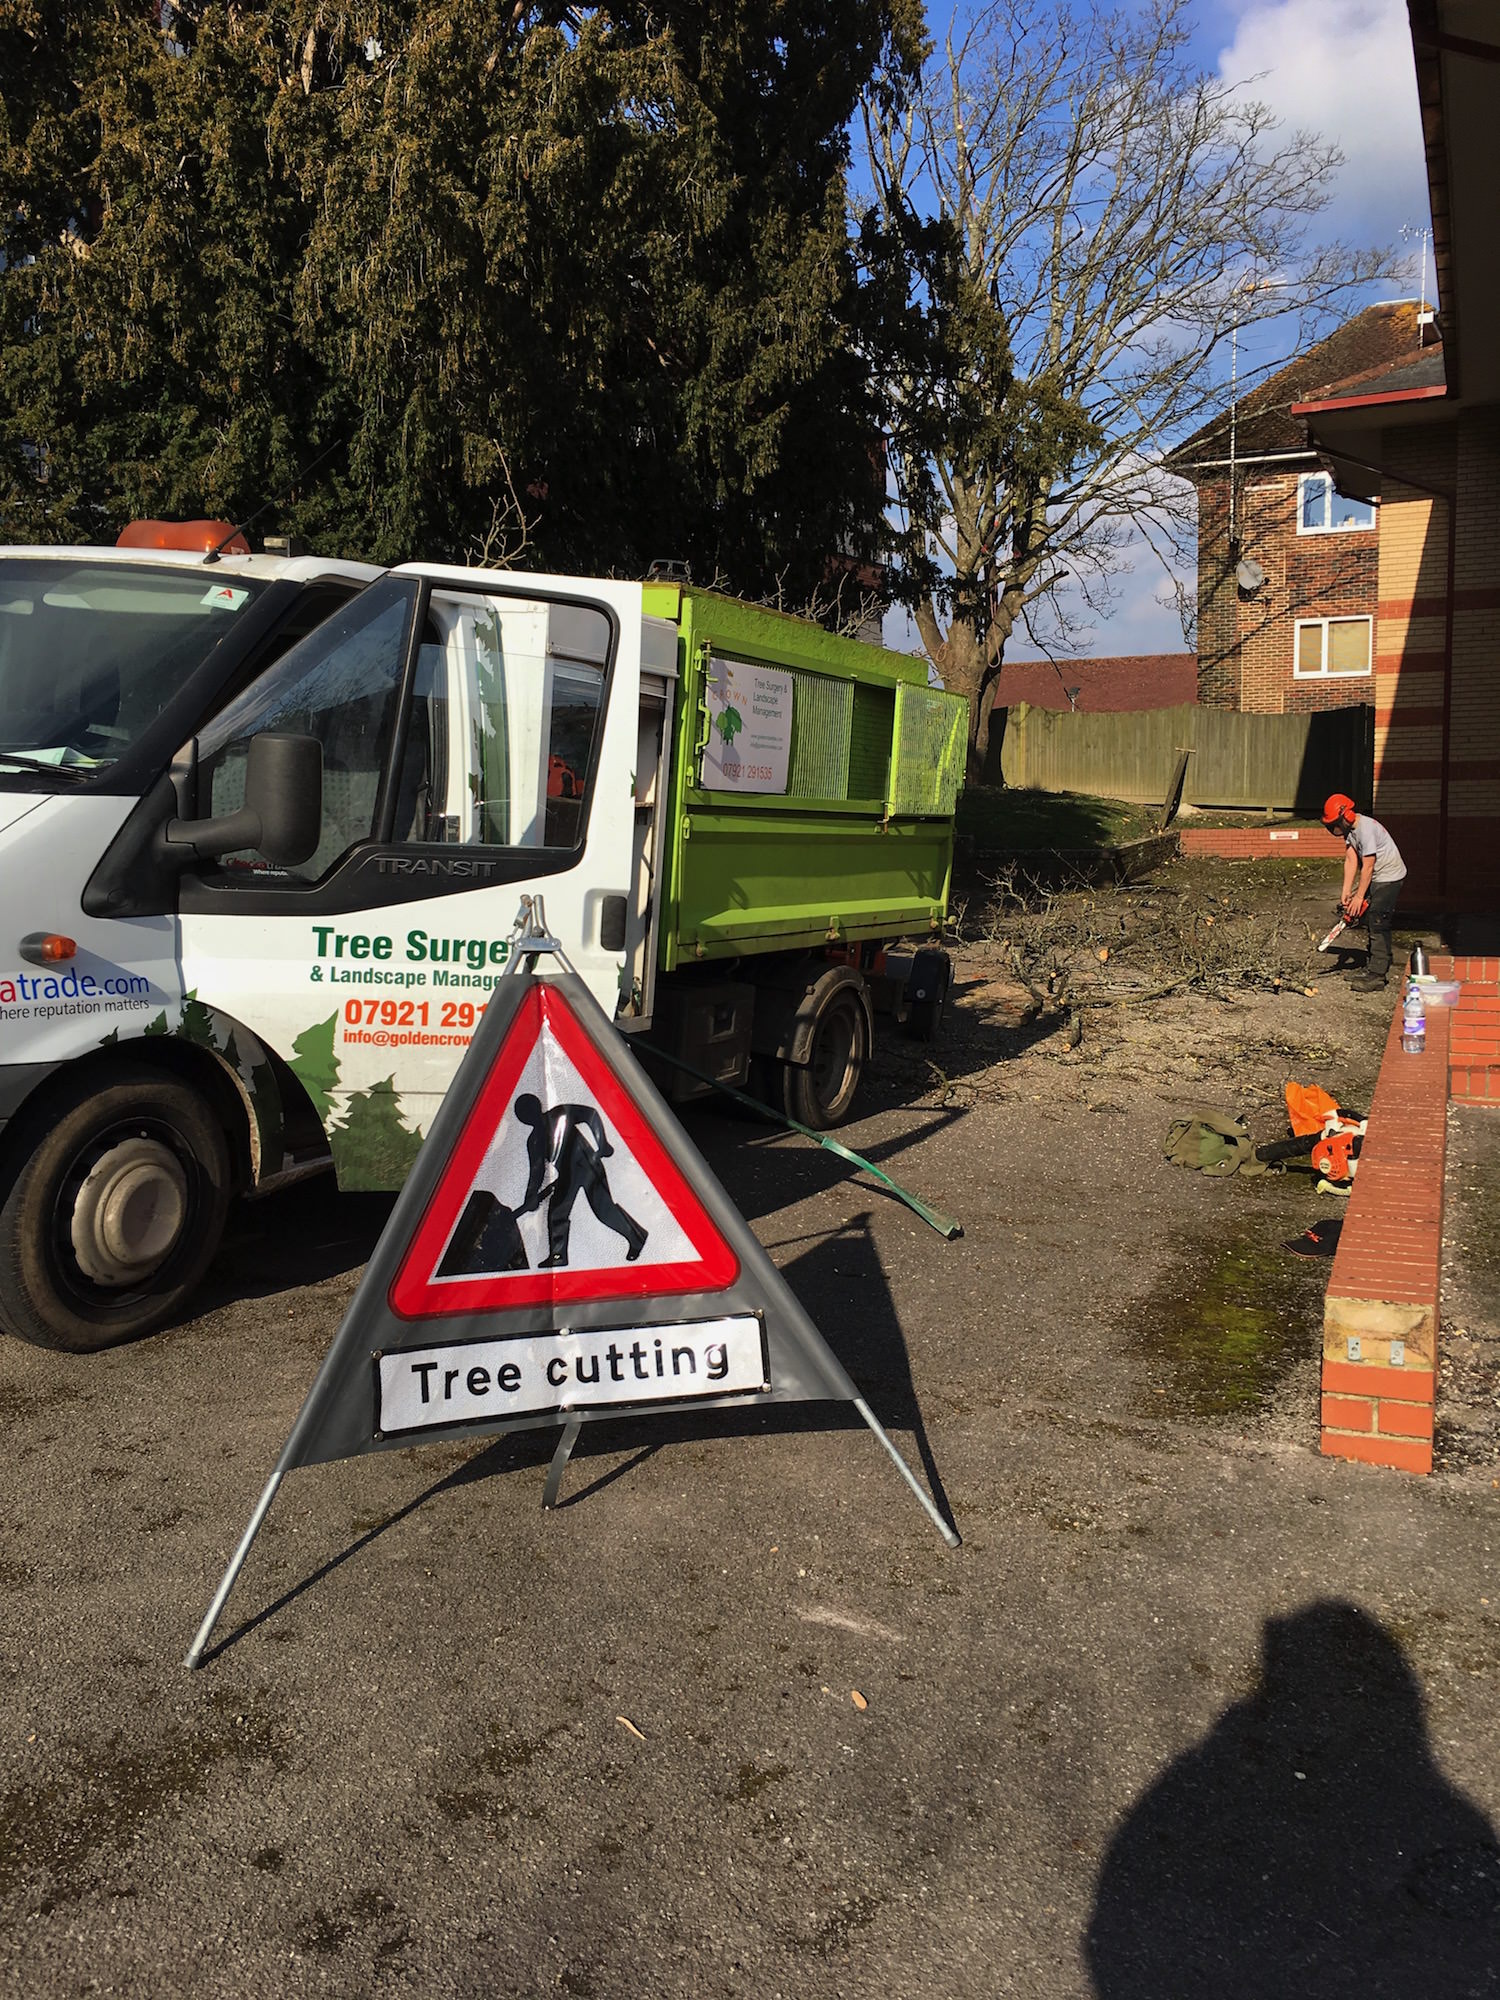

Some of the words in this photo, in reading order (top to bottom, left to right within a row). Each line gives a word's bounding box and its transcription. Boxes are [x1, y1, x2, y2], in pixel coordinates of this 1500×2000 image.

[754, 678, 765, 689] Tree
[766, 681, 783, 695] Surgery
[753, 692, 778, 705] Landscape
[752, 706, 782, 719] Management
[723, 763, 745, 779] 07921
[747, 765, 773, 780] 291535
[374, 857, 497, 877] TRANSIT
[312, 926, 393, 959] Tree
[406, 930, 509, 970] Surge
[0, 967, 150, 1003] atrade.com
[310, 966, 324, 982] &
[331, 966, 427, 988] Landscape
[0, 1006, 30, 1020] here
[34, 1001, 101, 1020] reputation
[104, 999, 150, 1012] matters
[344, 999, 429, 1027] 07921
[343, 1029, 473, 1047] info@goldencrow
[411, 1362, 522, 1403] Tree
[547, 1339, 729, 1386] cutting
